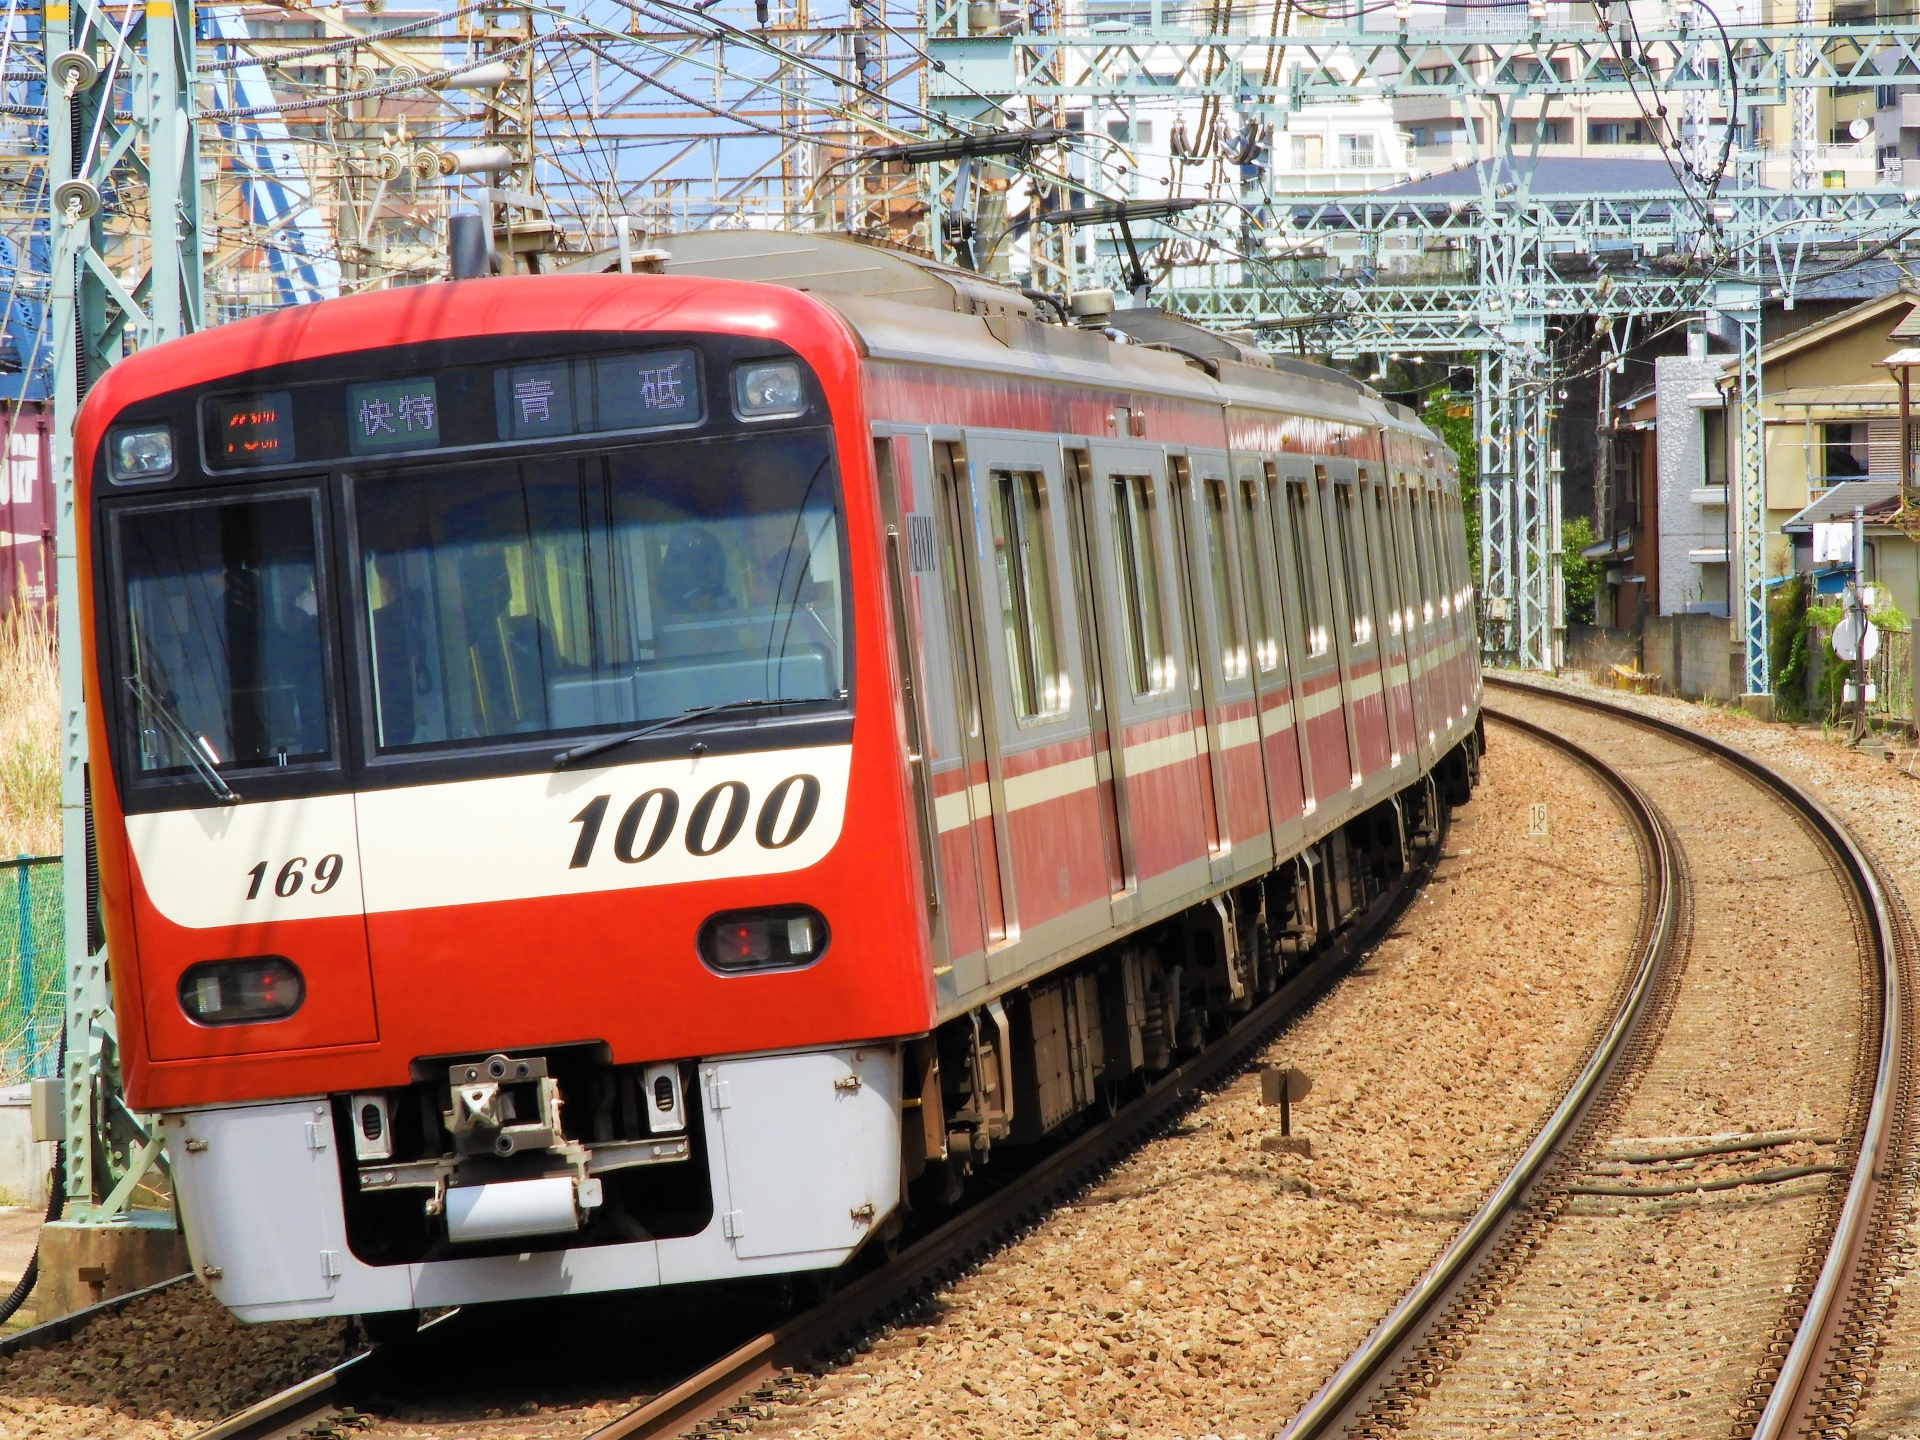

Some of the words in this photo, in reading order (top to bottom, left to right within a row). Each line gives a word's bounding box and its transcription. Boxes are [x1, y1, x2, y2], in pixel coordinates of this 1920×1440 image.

[358, 392, 436, 437] 快特
[568, 773, 821, 870] 1000
[1530, 805, 1546, 821] 16
[1532, 821, 1543, 832] K
[245, 853, 344, 900] 169
